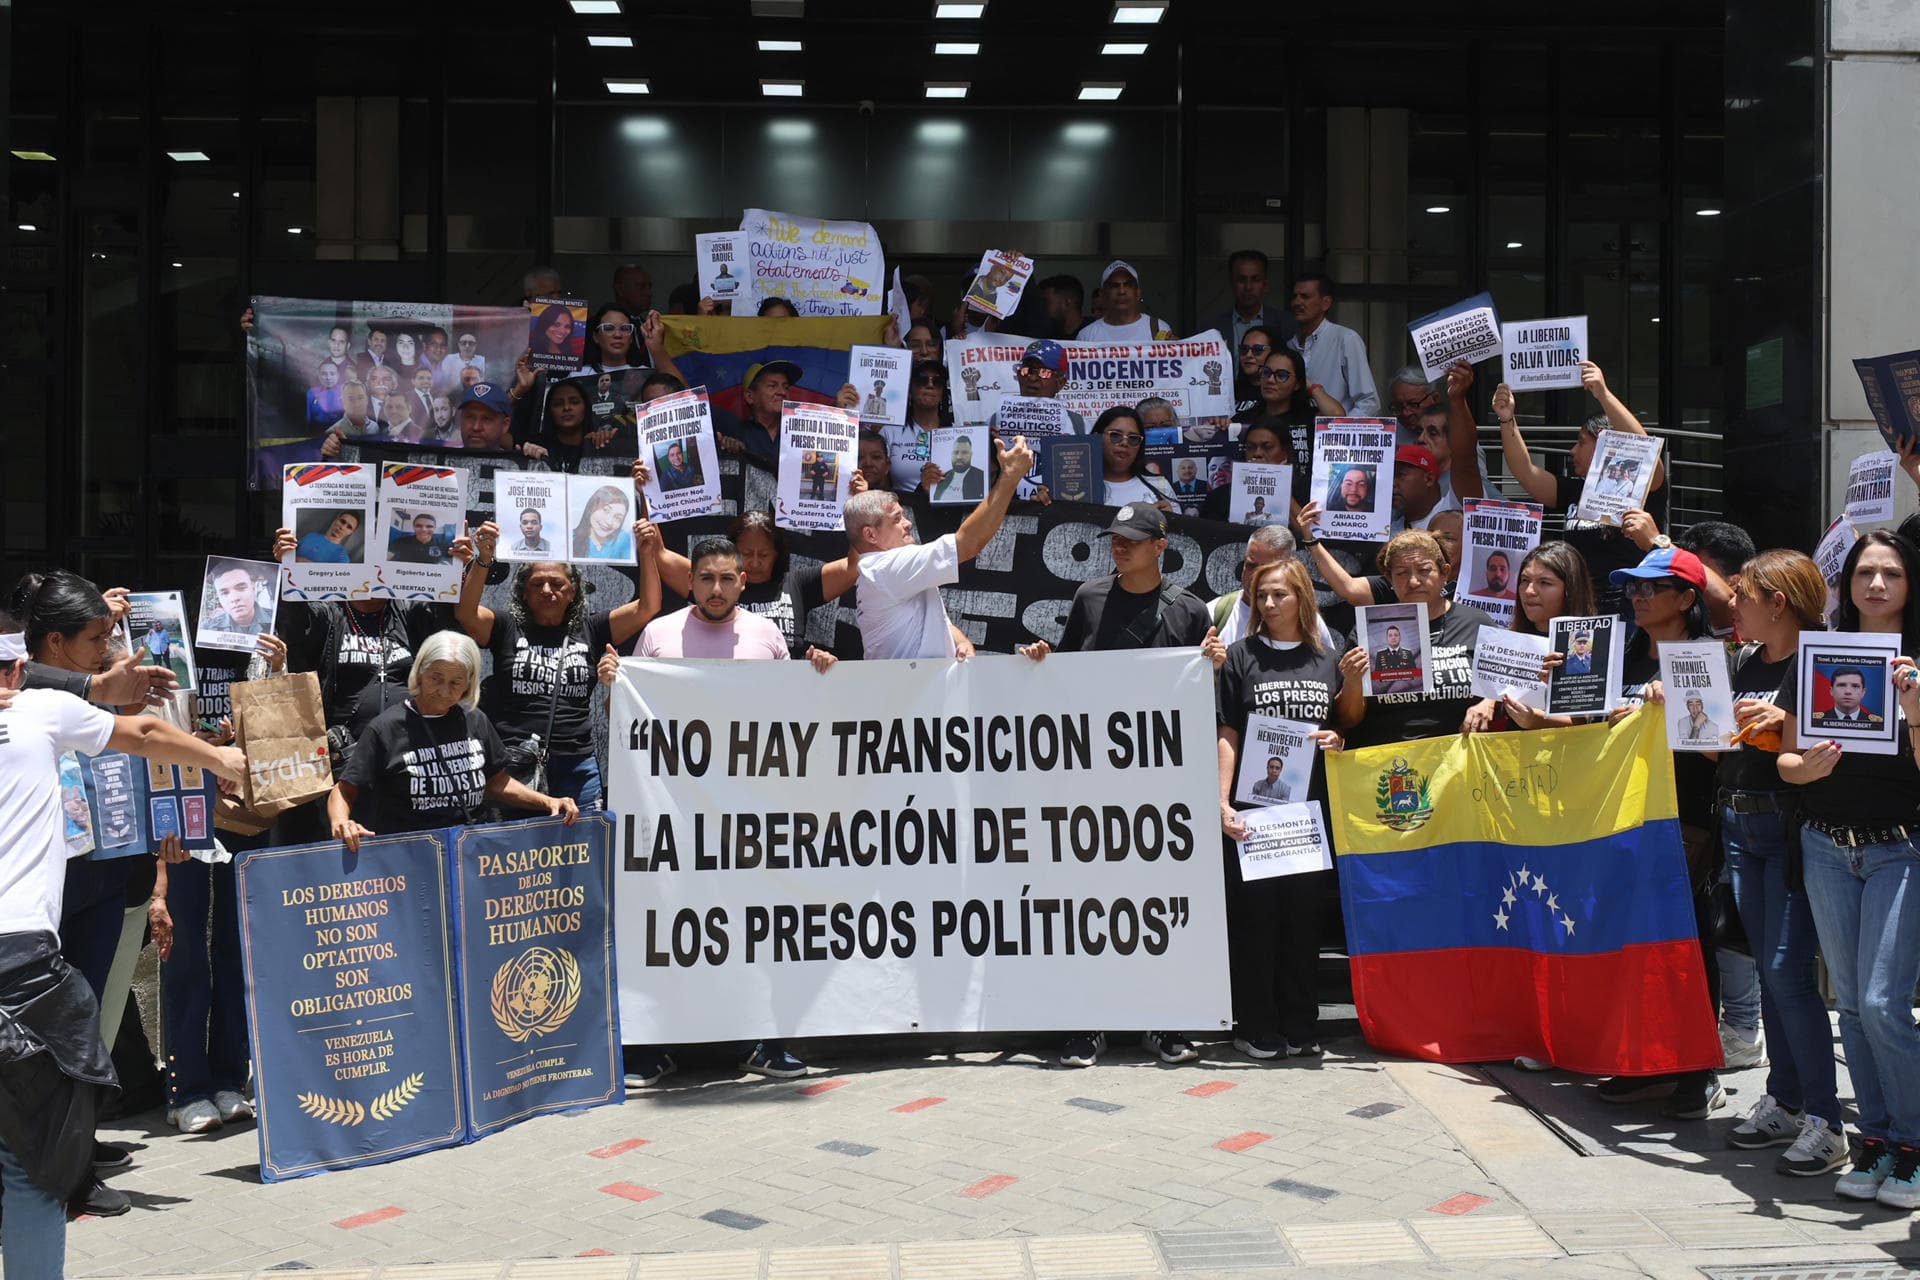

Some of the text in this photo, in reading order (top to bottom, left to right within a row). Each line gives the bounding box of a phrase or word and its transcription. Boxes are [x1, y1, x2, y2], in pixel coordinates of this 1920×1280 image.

[813, 221, 867, 247] demand
[712, 252, 734, 262] BADUEL
[1420, 312, 1487, 339] SIN LIBERTAD PLENA
[1420, 317, 1489, 346] PARA PRESOS
[1430, 325, 1490, 349] PERSEGUIDOS
[1518, 327, 1570, 344] LA LIBERTAD
[1134, 342, 1220, 358] Y JUSTICIA!
[1425, 331, 1495, 360] POLÍTICOS
[860, 358, 898, 369] LUIS MANUEL
[1510, 349, 1579, 370] SALVA VIDAS
[870, 368, 888, 379] PAIVA
[1066, 360, 1182, 380] INOCENTES
[1087, 380, 1154, 389] 3 DE ENERO
[641, 403, 707, 434] ¡LIBERTAD A TODOS LOS
[1001, 420, 1061, 431] POLÍTICOS
[646, 428, 668, 444] PRESOS
[785, 418, 856, 438] ¡LIBERTAD A TODOS LOS
[790, 437, 815, 450] PRESOS
[1319, 433, 1392, 449] ¡LIBERTAD A TODOS LOS
[1324, 449, 1347, 462] PRESOS
[1242, 473, 1277, 487] JOSÉ ÁNGEL
[508, 484, 552, 498] JOSÉ MIGUEL
[665, 492, 688, 500] Raimer
[1247, 486, 1275, 496] BARRENO
[516, 497, 546, 508] ESTRADA
[658, 496, 712, 509] López Chinchilla
[1467, 515, 1538, 534] ¡LIBERTAD A TODOS LOS
[1472, 531, 1495, 547] PRESOS
[1557, 618, 1610, 632] LIBERTAD
[1481, 644, 1545, 662] SIN DESMONTAR
[1478, 660, 1508, 675] NINGÚN
[1671, 660, 1709, 674] ENMANUEL
[512, 680, 545, 694] PRESOS
[1254, 680, 1328, 692] LIBEREN A TODOS
[1478, 673, 1538, 691] TIENE GARANTÍAS
[1673, 674, 1712, 688] DE LA ROSA
[1255, 690, 1329, 705] LOS PRESOS
[1255, 701, 1329, 720] POLÍTICOS
[1822, 721, 1872, 729] #LIBERENAIGBERT
[728, 721, 820, 777] HAY
[832, 713, 1092, 777] TRANSICION
[1107, 709, 1184, 769] SIN
[1257, 730, 1303, 748] HENRYBERTH
[1268, 744, 1289, 757] RIVAS
[410, 777, 426, 795] DE
[624, 795, 1194, 872] LA LIBERACIÓN DE TODOS
[1260, 818, 1317, 832] DESMONTAR
[1244, 835, 1320, 853] NINGÚN ACUERDO
[478, 842, 590, 878] PASAPORTE
[1248, 852, 1272, 862] TIENE
[518, 872, 552, 890] DE LOS
[282, 875, 406, 906] LOS DERECHOS
[484, 886, 585, 920] DERECHOS
[305, 899, 389, 926] HUMANOS
[316, 922, 378, 946] NO SON
[489, 911, 581, 946] HUMANOS
[646, 884, 1189, 968] LOS PRESOS POLÍTICOS”
[303, 942, 397, 970] OPTATIVOS.
[335, 967, 370, 989] SON
[290, 983, 413, 1017] OBLIGATORIOS
[324, 1029, 394, 1050] VENEZUELA
[325, 1044, 394, 1067] ES HORA DE
[334, 1061, 390, 1081] CUMPLIR.
[506, 1056, 565, 1080] VENEZUELA CUMPLE.
[483, 1067, 593, 1101] LA DIGNIDAD NO TIENE FRONTERAS.
